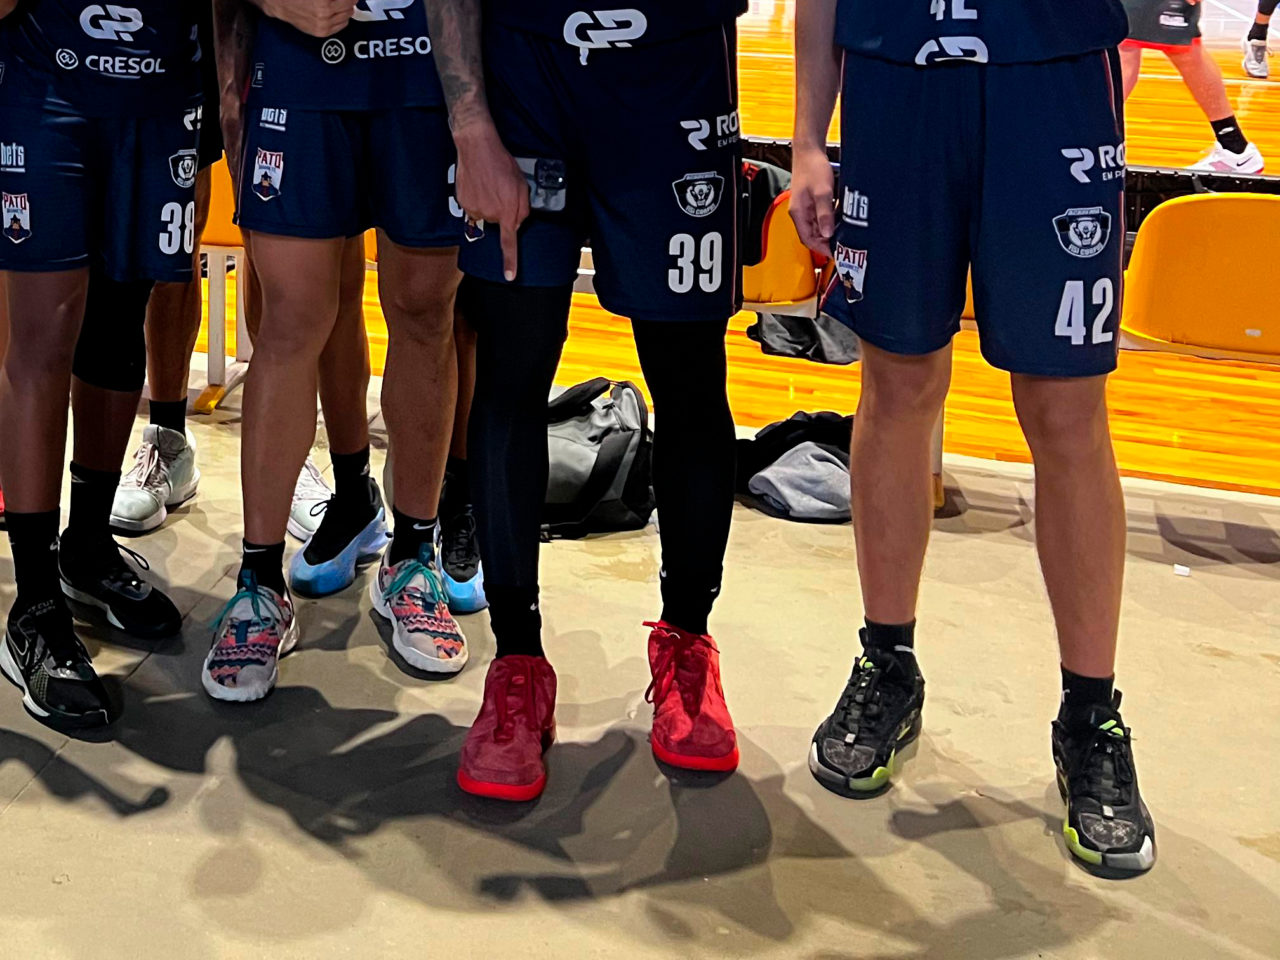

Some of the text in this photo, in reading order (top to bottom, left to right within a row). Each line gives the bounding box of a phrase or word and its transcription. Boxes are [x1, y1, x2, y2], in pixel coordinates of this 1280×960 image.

[353, 36, 432, 59] CRESO
[85, 54, 166, 74] CRESOL
[716, 110, 739, 137] RO
[0, 142, 25, 167] bets
[257, 151, 284, 170] PATO
[1098, 142, 1125, 169] RO
[2, 193, 27, 211] PATO
[843, 185, 869, 220] bets
[668, 231, 723, 294] 39
[837, 245, 867, 270] PATO
[1054, 277, 1114, 346] 42
